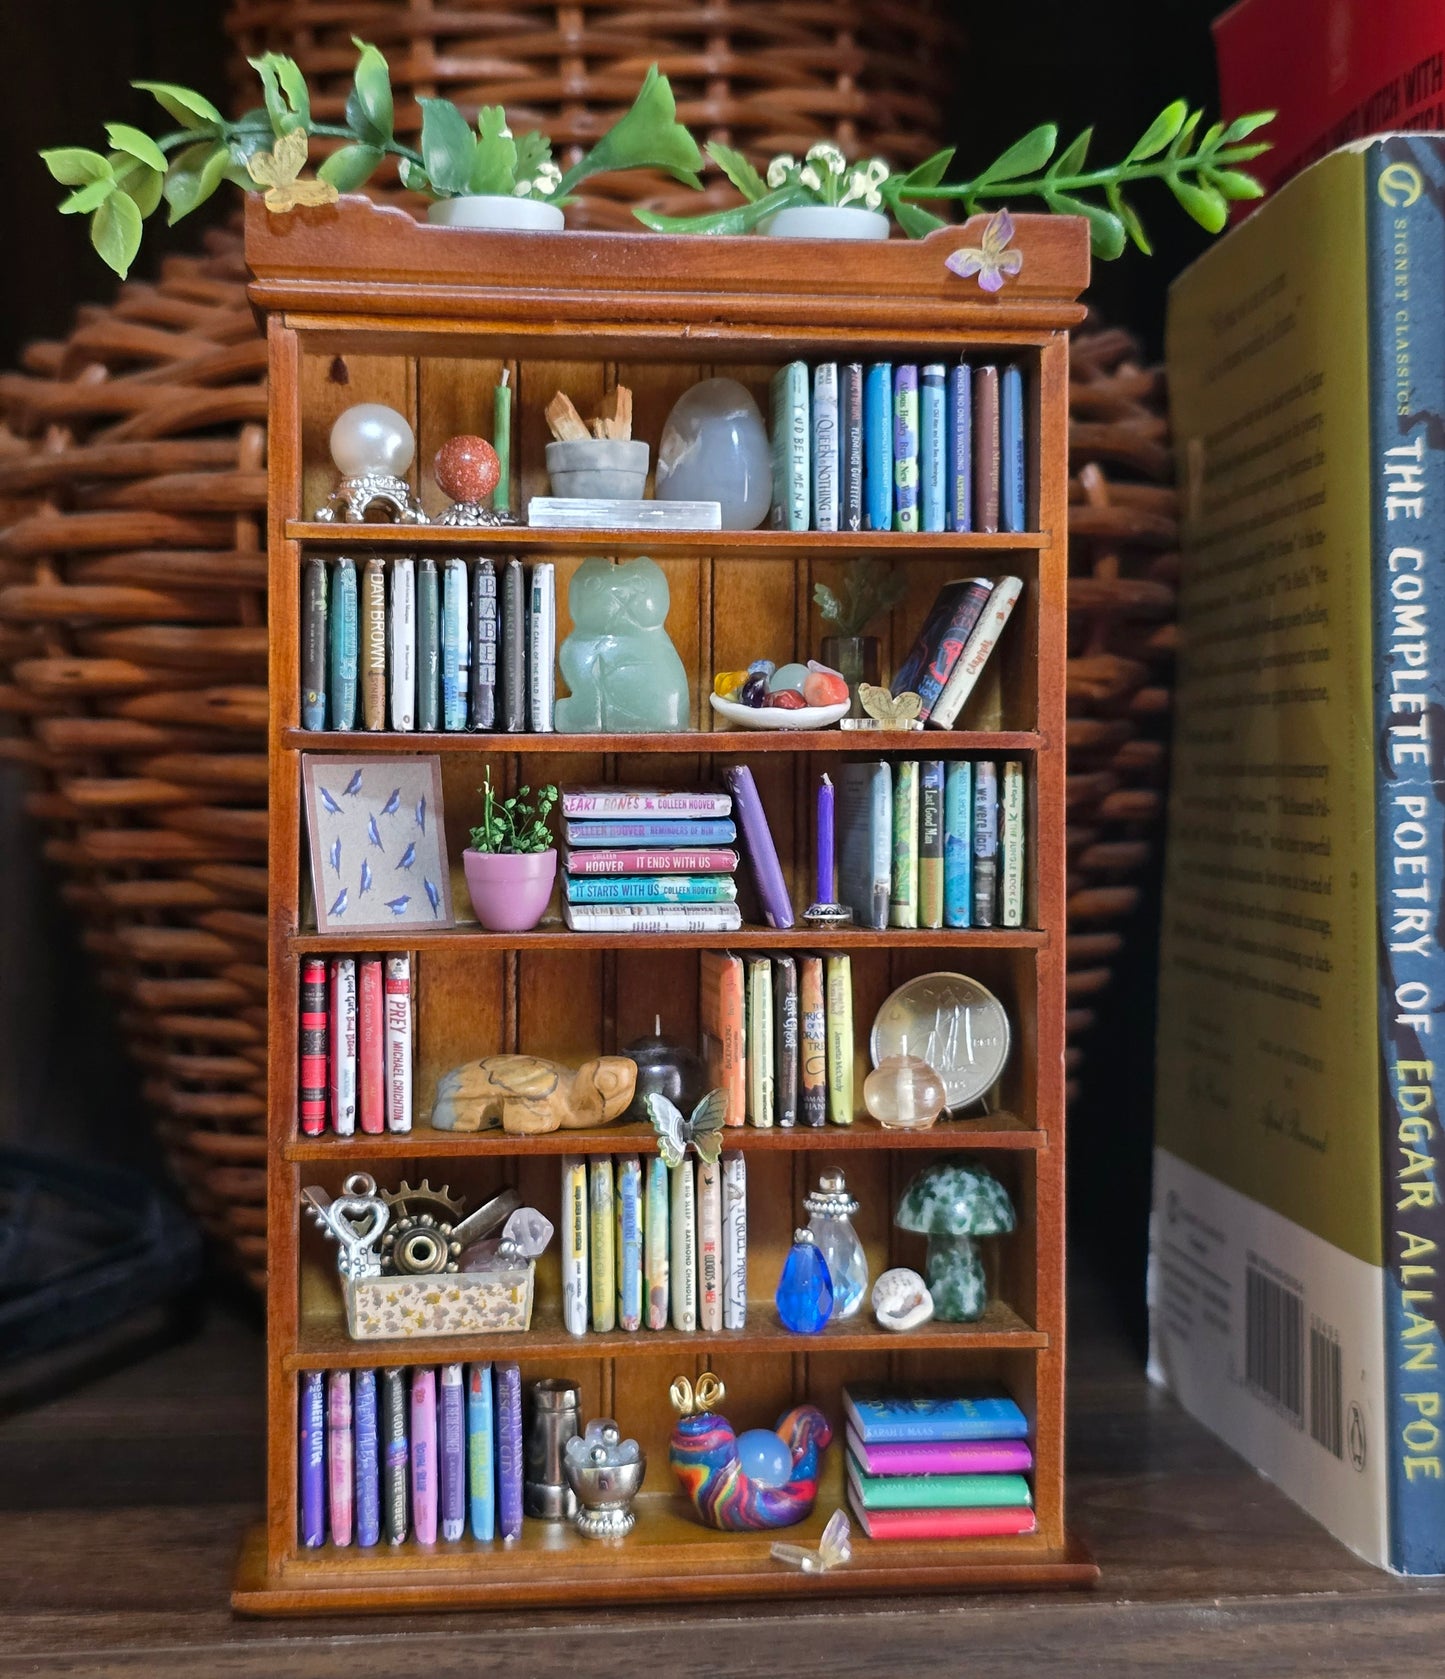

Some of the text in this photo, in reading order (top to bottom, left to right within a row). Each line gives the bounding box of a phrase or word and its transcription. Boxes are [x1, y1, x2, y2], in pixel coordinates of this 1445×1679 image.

[1404, 51, 1443, 108] WITH
[1394, 218, 1410, 416] SIGNET CLASSICS
[957, 371, 965, 393] WHEN
[957, 396, 964, 407] NO
[898, 381, 911, 509] Aldous Huxley Brave New World
[816, 419, 836, 511] QUEEN NOTHING
[957, 474, 965, 500] ALYSSA
[957, 502, 965, 520] COLE
[370, 573, 385, 605] DAN
[506, 575, 515, 600] DARK
[485, 578, 496, 684] BABEL
[507, 605, 515, 640] PLACES
[370, 610, 385, 668] BROWN
[658, 799, 687, 810] COLLEEN
[689, 800, 715, 810] HOOVER
[924, 774, 938, 844] The Last Good Man
[610, 825, 645, 837] HOOVER
[650, 826, 688, 836] REMINDERS
[690, 826, 698, 835] OF
[976, 788, 993, 852] we were liars
[586, 861, 624, 872] HOOVER
[636, 857, 711, 868] IT ENDS WITH US
[1009, 841, 1017, 870] JUNGLE
[576, 884, 717, 897] IT STARTS WITH US COLLEEN HOOVER
[1009, 874, 1017, 896] BOOK
[1383, 437, 1441, 1481] THE COMPLETE POETRY OF EDGAR ALLAN POE
[344, 975, 355, 993] Good
[364, 1003, 374, 1024] Love
[345, 1033, 355, 1057] Blood
[364, 1026, 374, 1042] You
[784, 1018, 798, 1048] Ghost
[390, 1000, 406, 1121] PREY MICHAEL CRICHTON
[834, 1031, 844, 1092] Jennette McCurdy
[735, 1214, 746, 1298] CRUEL PRINCE
[392, 1383, 402, 1411] NEON
[415, 1387, 425, 1403] RED
[311, 1399, 323, 1427] MEET
[392, 1414, 404, 1442] GODS
[499, 1384, 511, 1475] RESCENT CITY
[866, 1427, 896, 1438] SARAH
[907, 1427, 934, 1436] MAAS
[359, 1428, 377, 1462] TALES
[414, 1441, 427, 1468] ROYAL
[415, 1472, 427, 1492] BLUE
[394, 1494, 403, 1531] ROBERT
